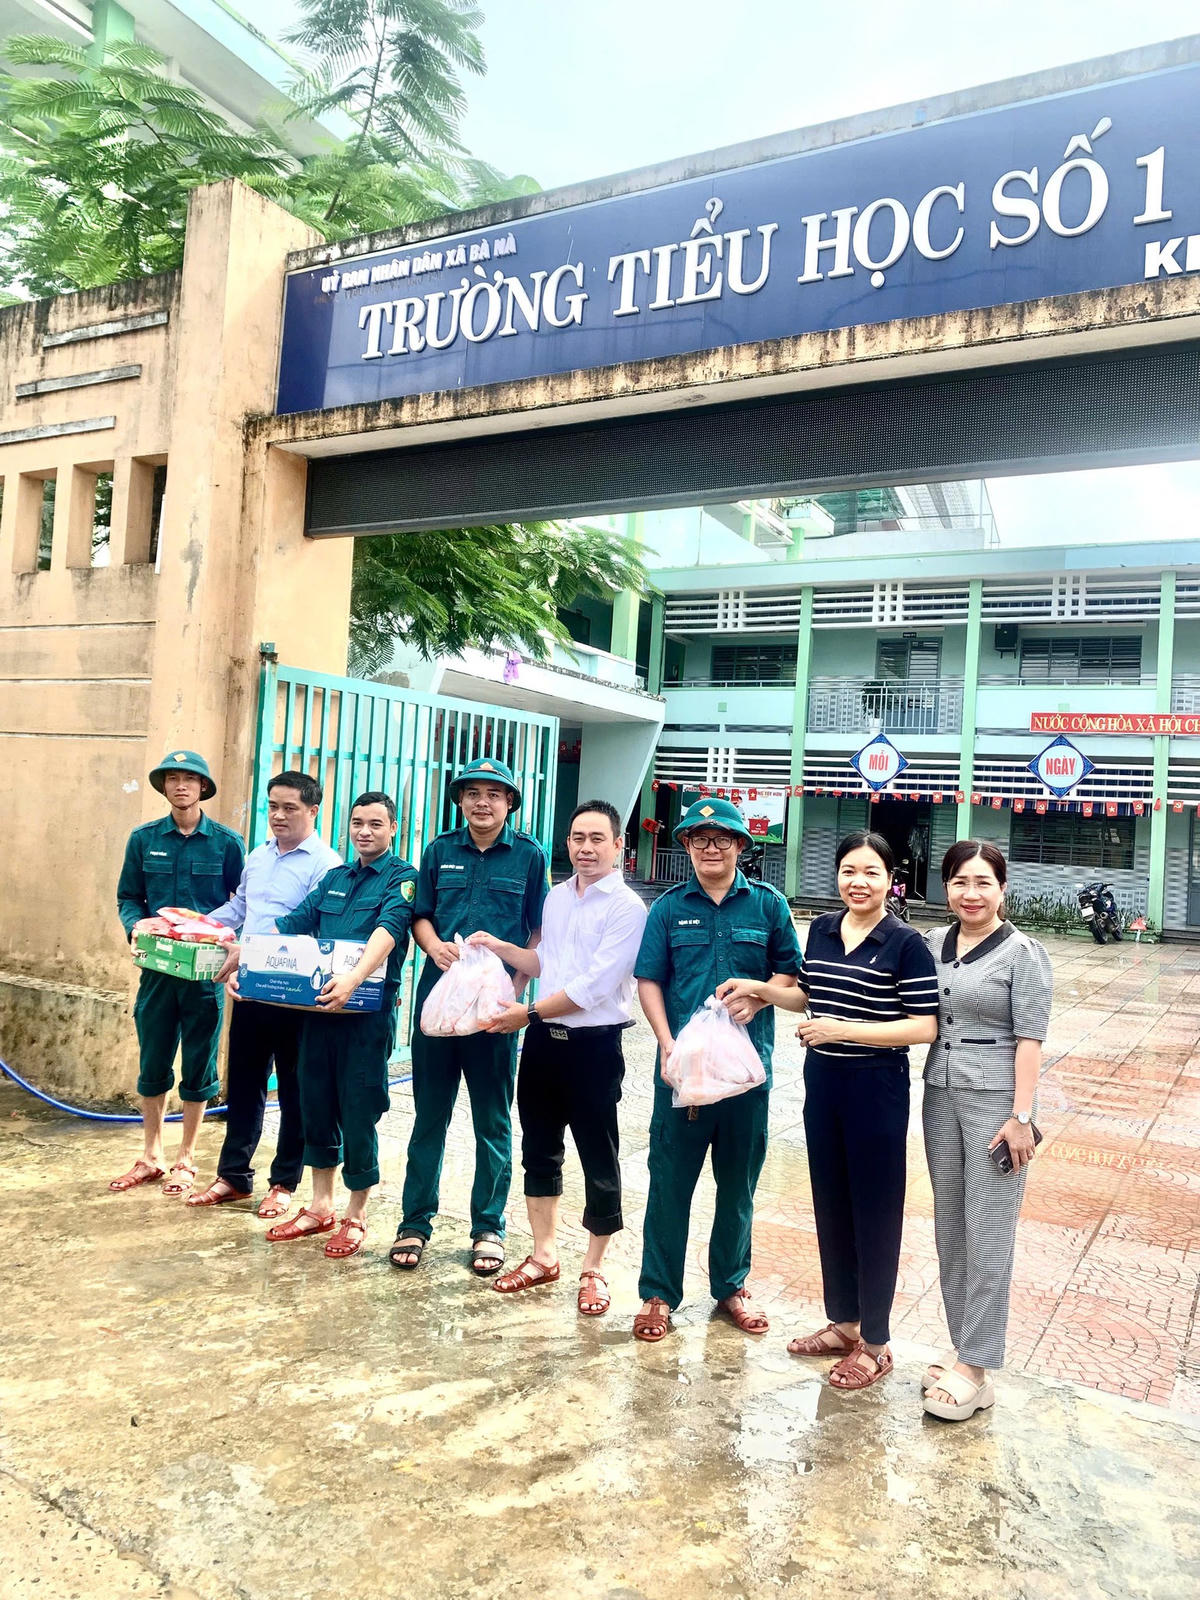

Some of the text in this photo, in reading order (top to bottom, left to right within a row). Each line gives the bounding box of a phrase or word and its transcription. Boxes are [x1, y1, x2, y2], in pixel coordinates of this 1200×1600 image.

[358, 116, 1173, 360] TRƯỜNG TIỂU HỌC SỐ 1
[341, 268, 370, 289] BAN
[370, 258, 409, 283] NHÂN
[412, 250, 443, 274] DÂN
[445, 244, 467, 267] XÃ
[469, 238, 491, 262] BÀ
[493, 232, 517, 257] NÀ
[1033, 713, 1070, 730] NƯỚC
[1071, 714, 1105, 732] CỘNG
[1107, 714, 1134, 731] HÒA
[1136, 715, 1156, 732] XÃ
[1159, 715, 1182, 733] HỘI
[868, 749, 889, 771] MỖI
[1045, 755, 1077, 776] NGÀY
[265, 955, 298, 969] AQUAFINA
